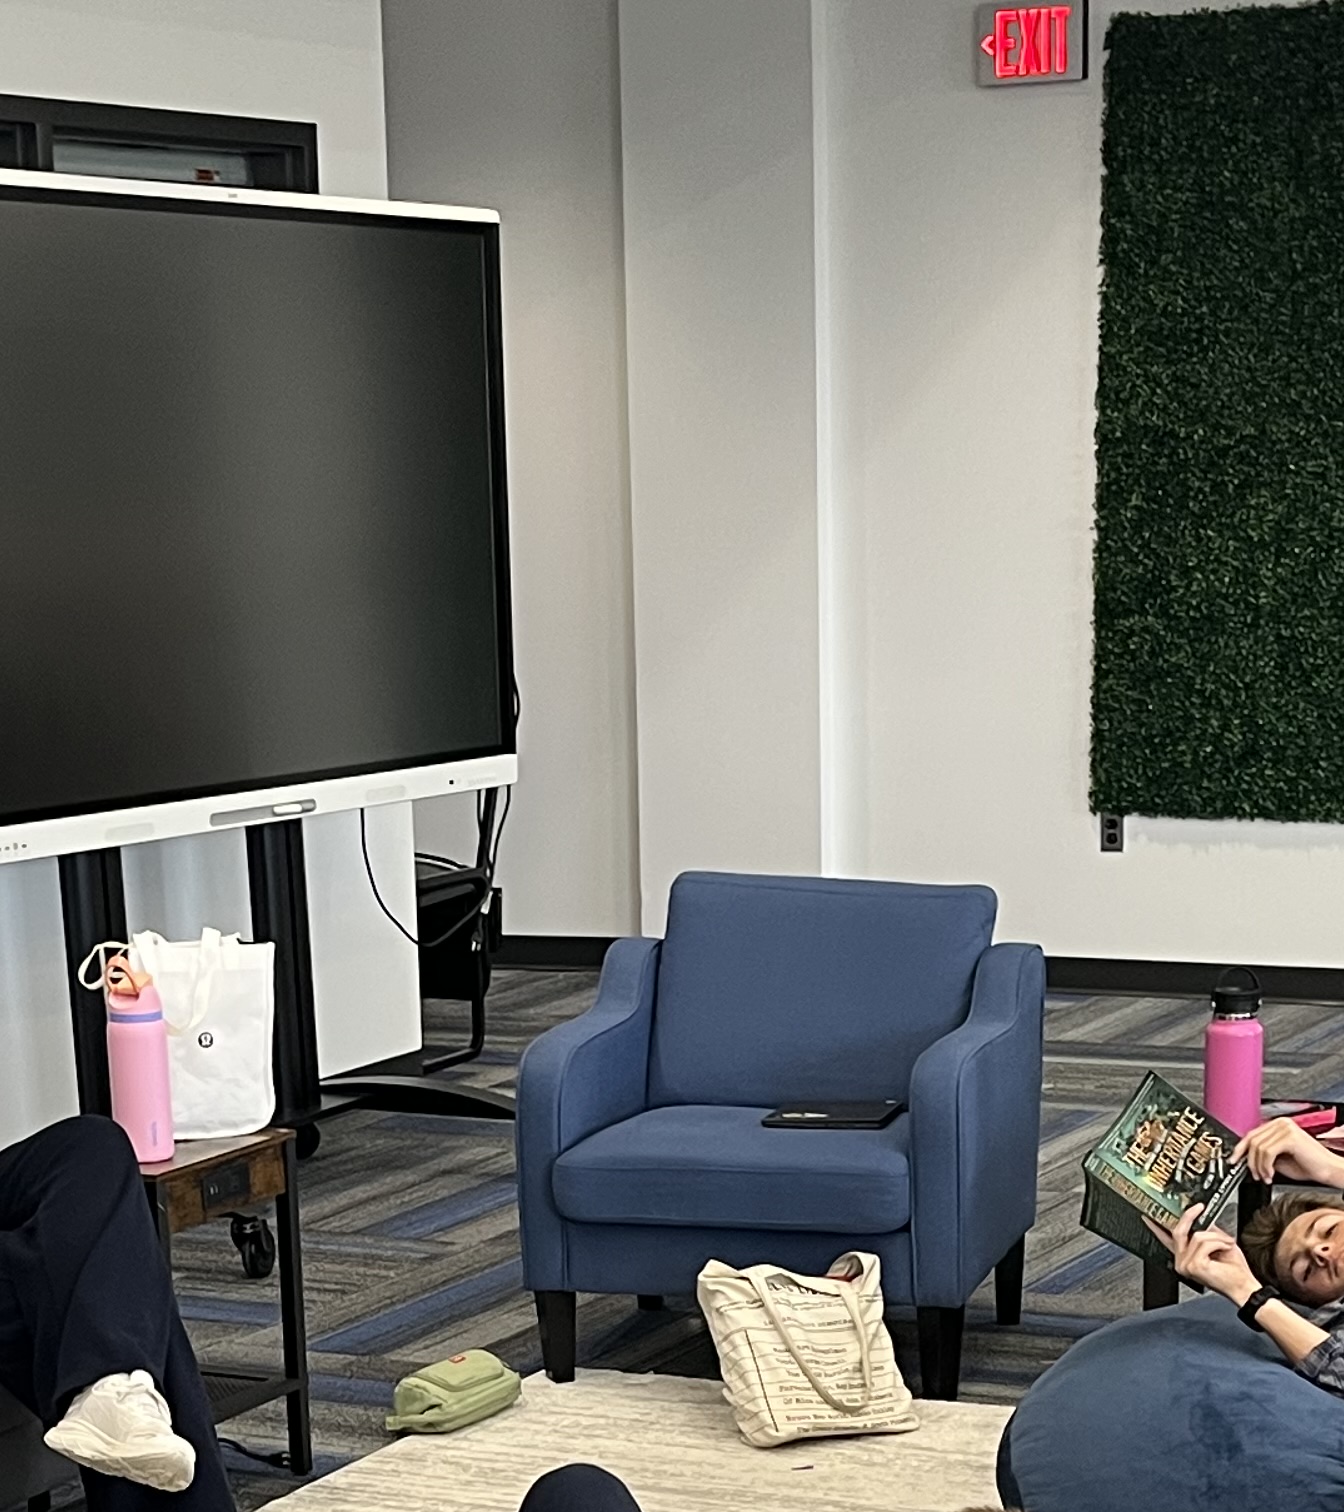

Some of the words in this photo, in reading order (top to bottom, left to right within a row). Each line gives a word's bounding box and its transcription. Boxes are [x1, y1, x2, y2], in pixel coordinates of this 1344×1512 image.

[995, 6, 1072, 78] EXIT
[1122, 1139, 1152, 1170] THE
[1142, 1106, 1206, 1193] INHERITANCE
